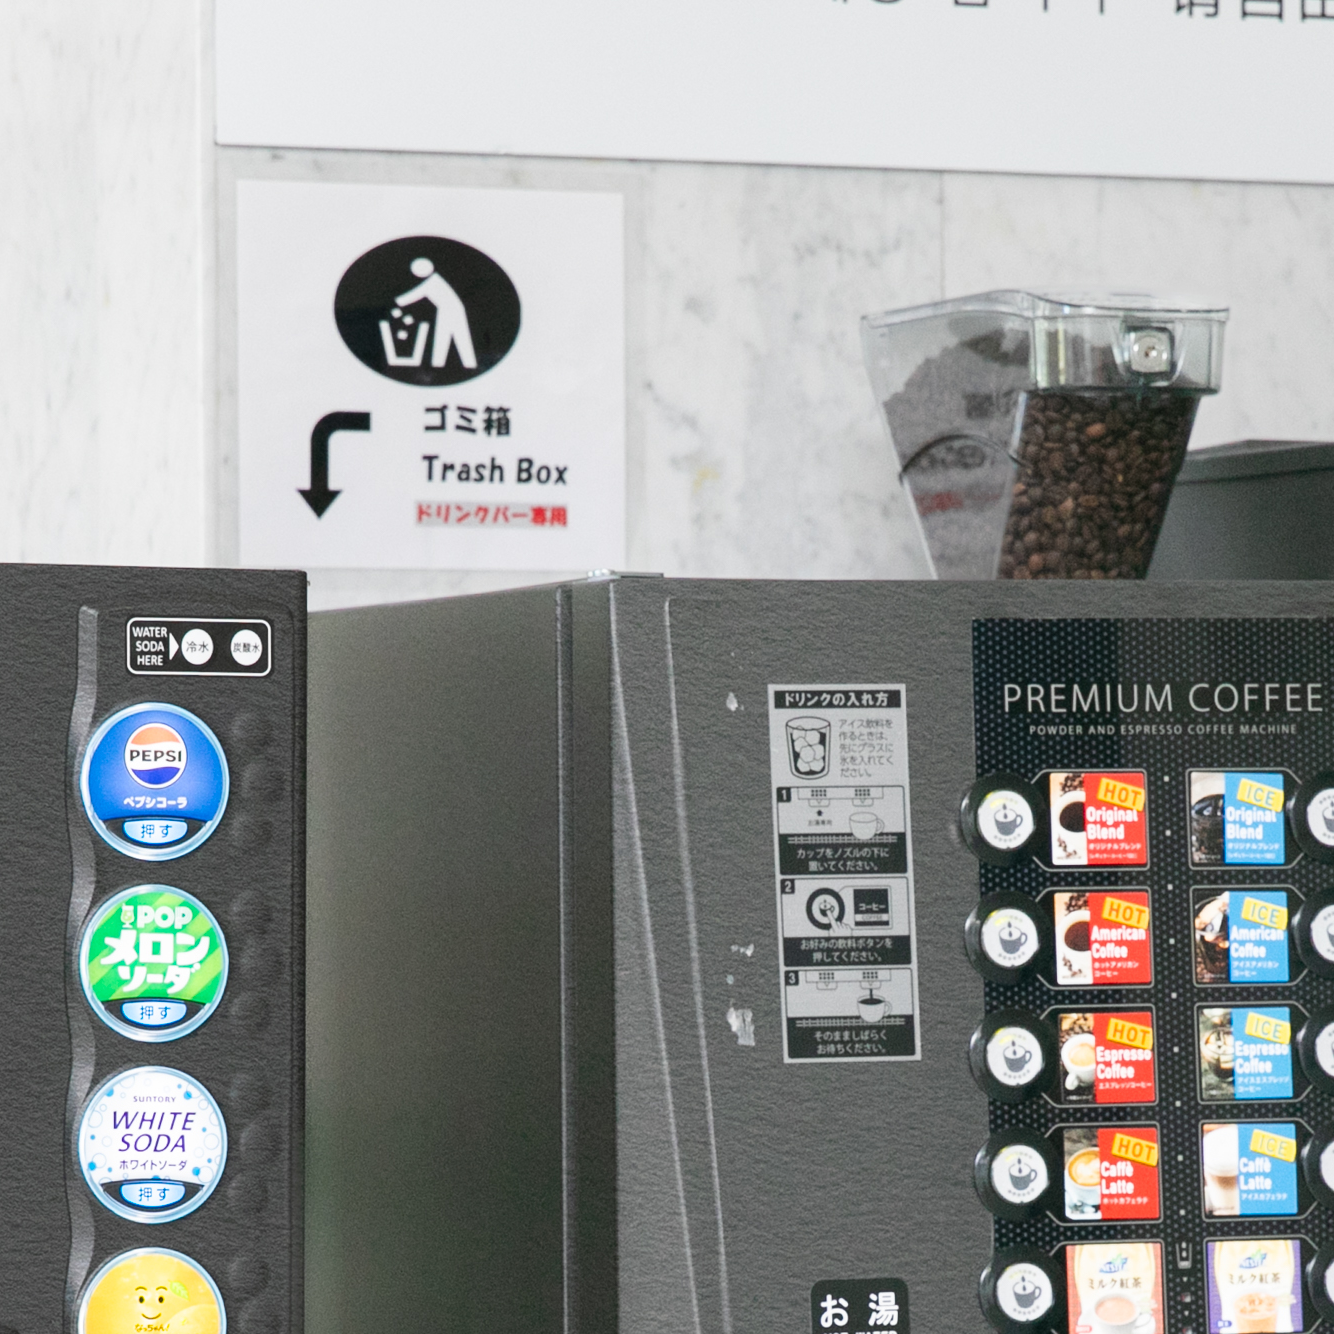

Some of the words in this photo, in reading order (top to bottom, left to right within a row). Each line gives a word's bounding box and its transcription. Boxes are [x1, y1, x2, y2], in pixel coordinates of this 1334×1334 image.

[423, 404, 511, 437] ゴミ箱
[422, 455, 504, 482] Trash
[516, 457, 568, 485] Box
[417, 504, 567, 527] ドリンクバー専用
[132, 626, 167, 638] WATER
[135, 641, 165, 652] SODA
[186, 641, 209, 653] 冷水
[233, 642, 261, 653] 炭酸水
[137, 655, 164, 666] HERE
[785, 692, 889, 707] ドリンクの入れ方
[1004, 684, 1174, 713] PREMIUM
[1188, 683, 1323, 712] COFFEE
[1029, 725, 1084, 736] POWDER
[1088, 725, 1116, 735] AND
[1120, 724, 1183, 736] ESPRESSO
[1188, 724, 1234, 735] COFFEE
[1240, 724, 1297, 735] MACHINE
[129, 750, 182, 762] PEPSI
[123, 796, 188, 808] ペプシコーラ
[781, 789, 787, 800] 1
[1104, 781, 1142, 807] HOT
[1246, 784, 1276, 807] ICE
[1085, 806, 1139, 826] Original
[1225, 806, 1277, 826] Original
[141, 824, 172, 839] 押す
[1087, 824, 1125, 840] Blend
[1226, 824, 1264, 840] Blend
[797, 847, 890, 859] カップをノズルの下に
[785, 881, 792, 892] 2
[859, 903, 886, 912] コーヒー
[1108, 900, 1147, 925] HOT
[1251, 902, 1280, 925] ICE
[137, 905, 193, 929] POP
[1091, 925, 1146, 941] American
[1230, 925, 1285, 941] American
[100, 929, 210, 965] メロン
[1091, 943, 1128, 959] Coffee
[1230, 943, 1267, 958] Coffee
[117, 962, 201, 994] ソーダ
[789, 973, 796, 984] 3
[1094, 970, 1119, 978] コーヒー
[1233, 970, 1258, 978] コーヒー
[140, 1005, 171, 1020] 押す
[1112, 1021, 1151, 1046] HOT
[1254, 1018, 1284, 1041] ICE
[1096, 1046, 1152, 1064] Espresso
[1235, 1040, 1289, 1059] Espresso
[1096, 1063, 1135, 1079] Coffee
[1236, 1058, 1273, 1074] Coffee
[1238, 1085, 1262, 1093] コーヒー
[113, 1111, 196, 1131] WHITE
[118, 1133, 186, 1152] SODA
[1118, 1137, 1156, 1162] HOT
[1259, 1134, 1289, 1157] ICE
[119, 1159, 188, 1171] ホワイトソーダ
[1102, 1178, 1134, 1195] Latte
[1239, 1175, 1272, 1191] Latte
[138, 1187, 170, 1202] 押す
[1088, 1277, 1142, 1290] ミルク紅茶
[1228, 1272, 1282, 1285] ミルク紅茶
